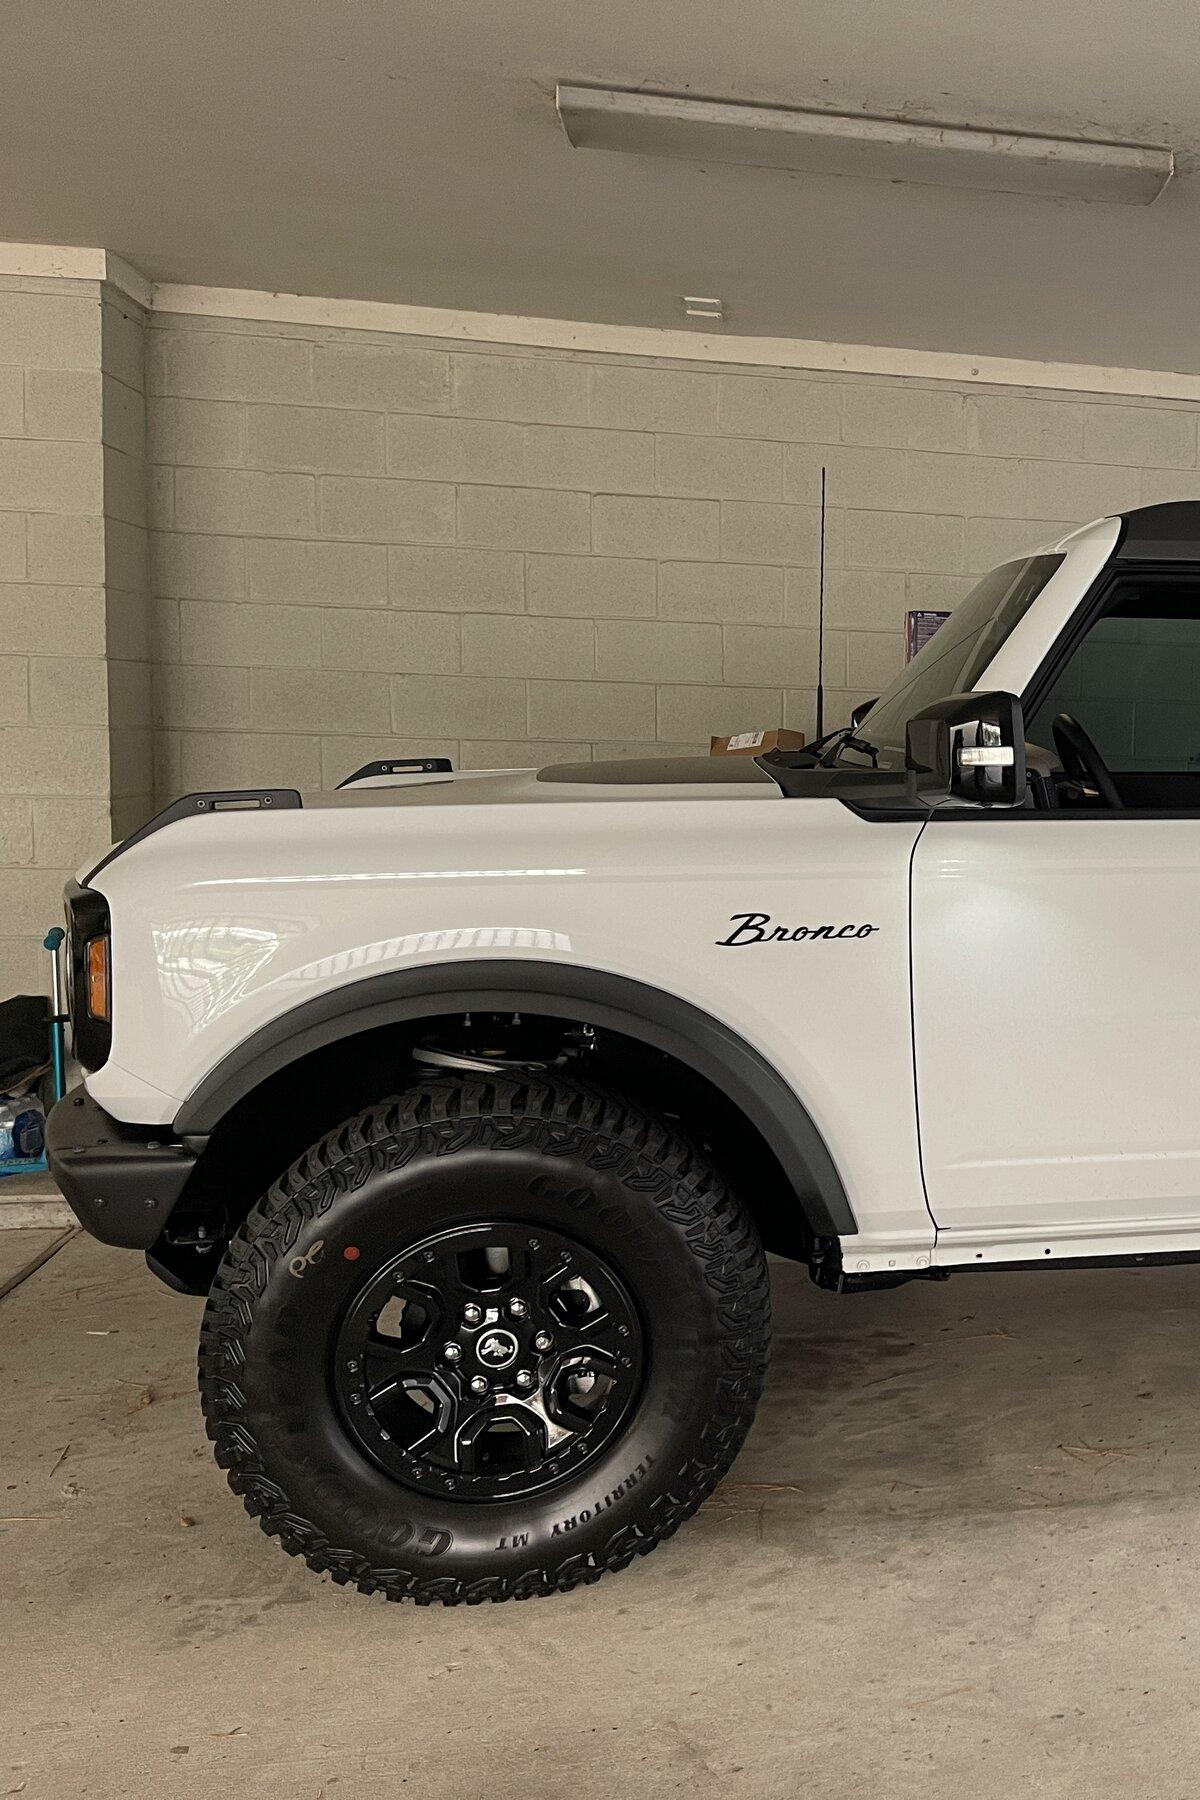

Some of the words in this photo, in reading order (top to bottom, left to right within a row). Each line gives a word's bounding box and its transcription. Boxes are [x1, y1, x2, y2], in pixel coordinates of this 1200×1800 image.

[715, 912, 880, 946] Bronco
[550, 1454, 656, 1539] TERRITORY
[494, 1532, 530, 1551] MT
